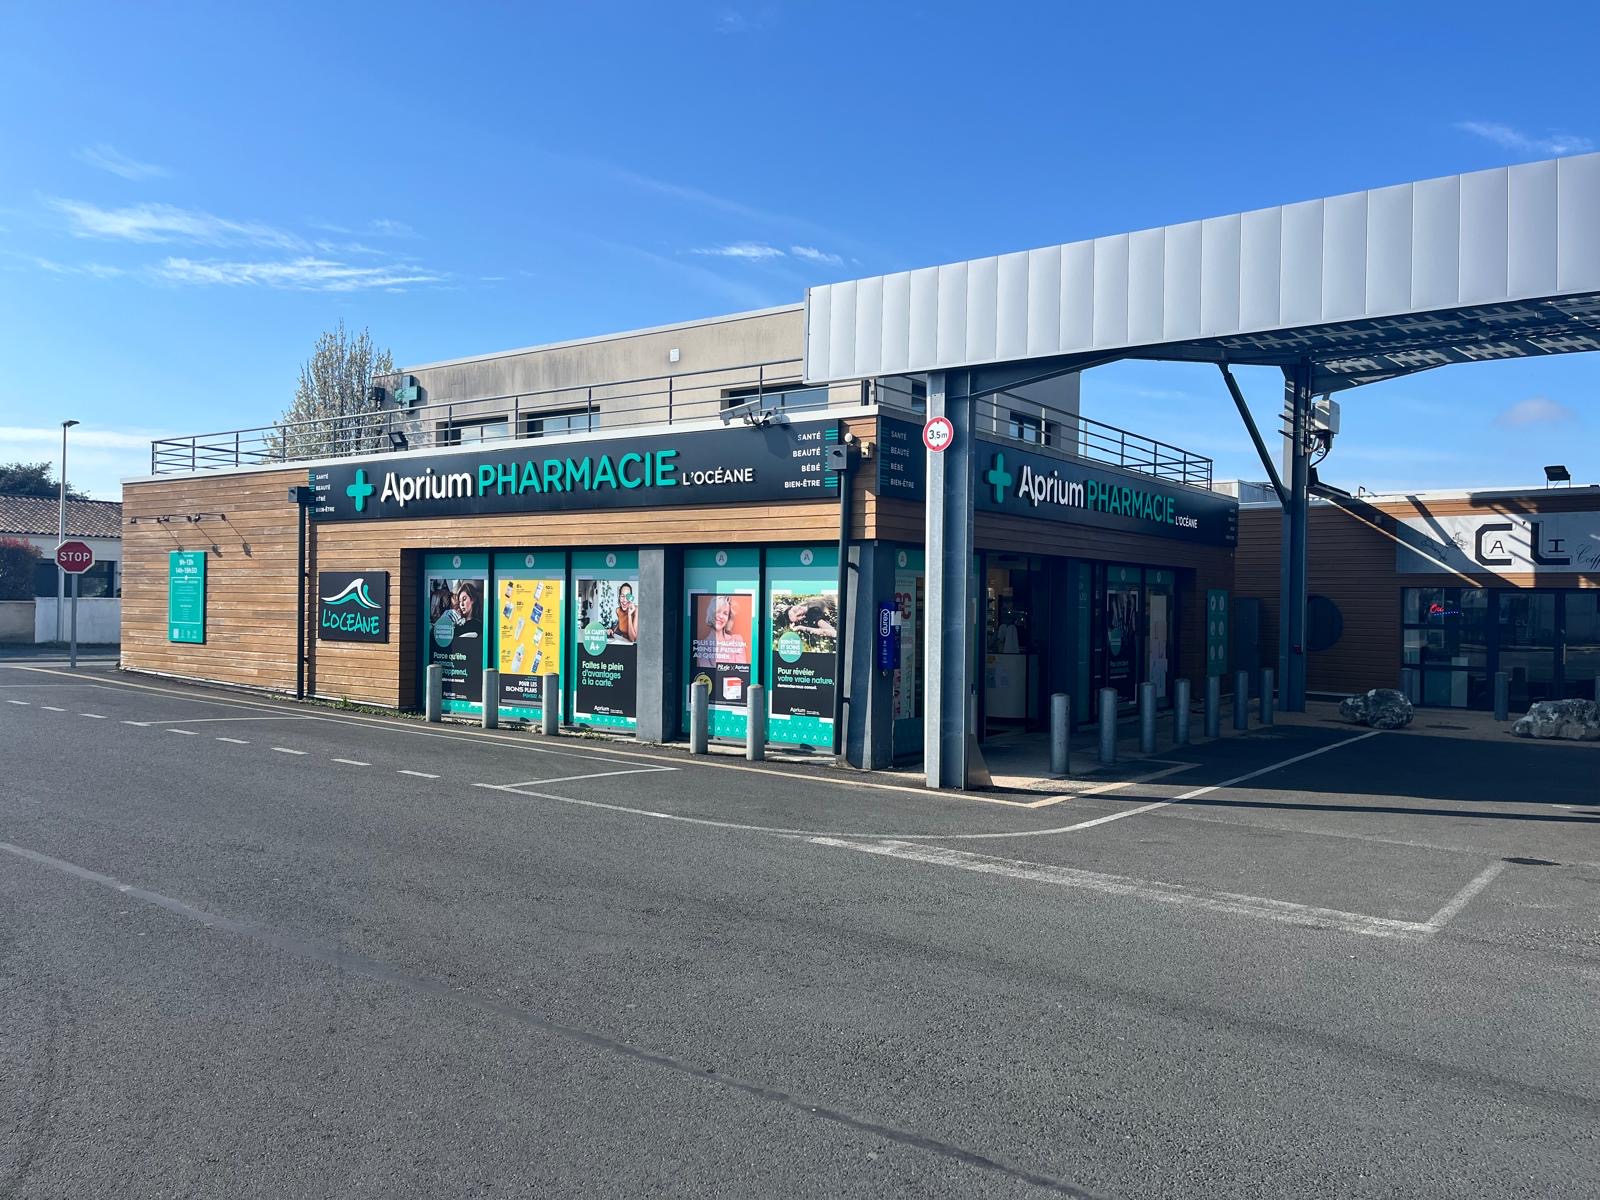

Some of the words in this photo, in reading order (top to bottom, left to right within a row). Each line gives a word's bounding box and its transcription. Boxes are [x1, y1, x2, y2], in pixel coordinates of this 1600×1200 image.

[797, 431, 821, 441] SANTÉ
[891, 430, 907, 440] SANTÉ
[792, 447, 821, 458] BEAUTÉ
[890, 446, 910, 457] BEAUTÉ
[801, 461, 821, 472] BÉBÉ
[890, 462, 904, 471] BÉBÉ
[380, 467, 472, 507] Aprium
[478, 450, 677, 497] PHARMACIE
[682, 466, 753, 486] L'OCÉANE
[784, 477, 821, 489] BIEN-ÊTRE
[890, 478, 915, 489] BIEN-ÊTRE
[1018, 465, 1084, 507] Aprium
[1087, 479, 1175, 524] PHARMACIE
[60, 551, 90, 562] STOP
[589, 641, 600, 651] A+
[582, 660, 600, 669] Faites
[608, 662, 624, 671] plein
[777, 667, 792, 675] Pour
[792, 668, 815, 676] révéler
[595, 678, 613, 687] carte.
[777, 675, 793, 683] votre
[794, 676, 810, 684] vraie
[811, 678, 835, 686] nature,
